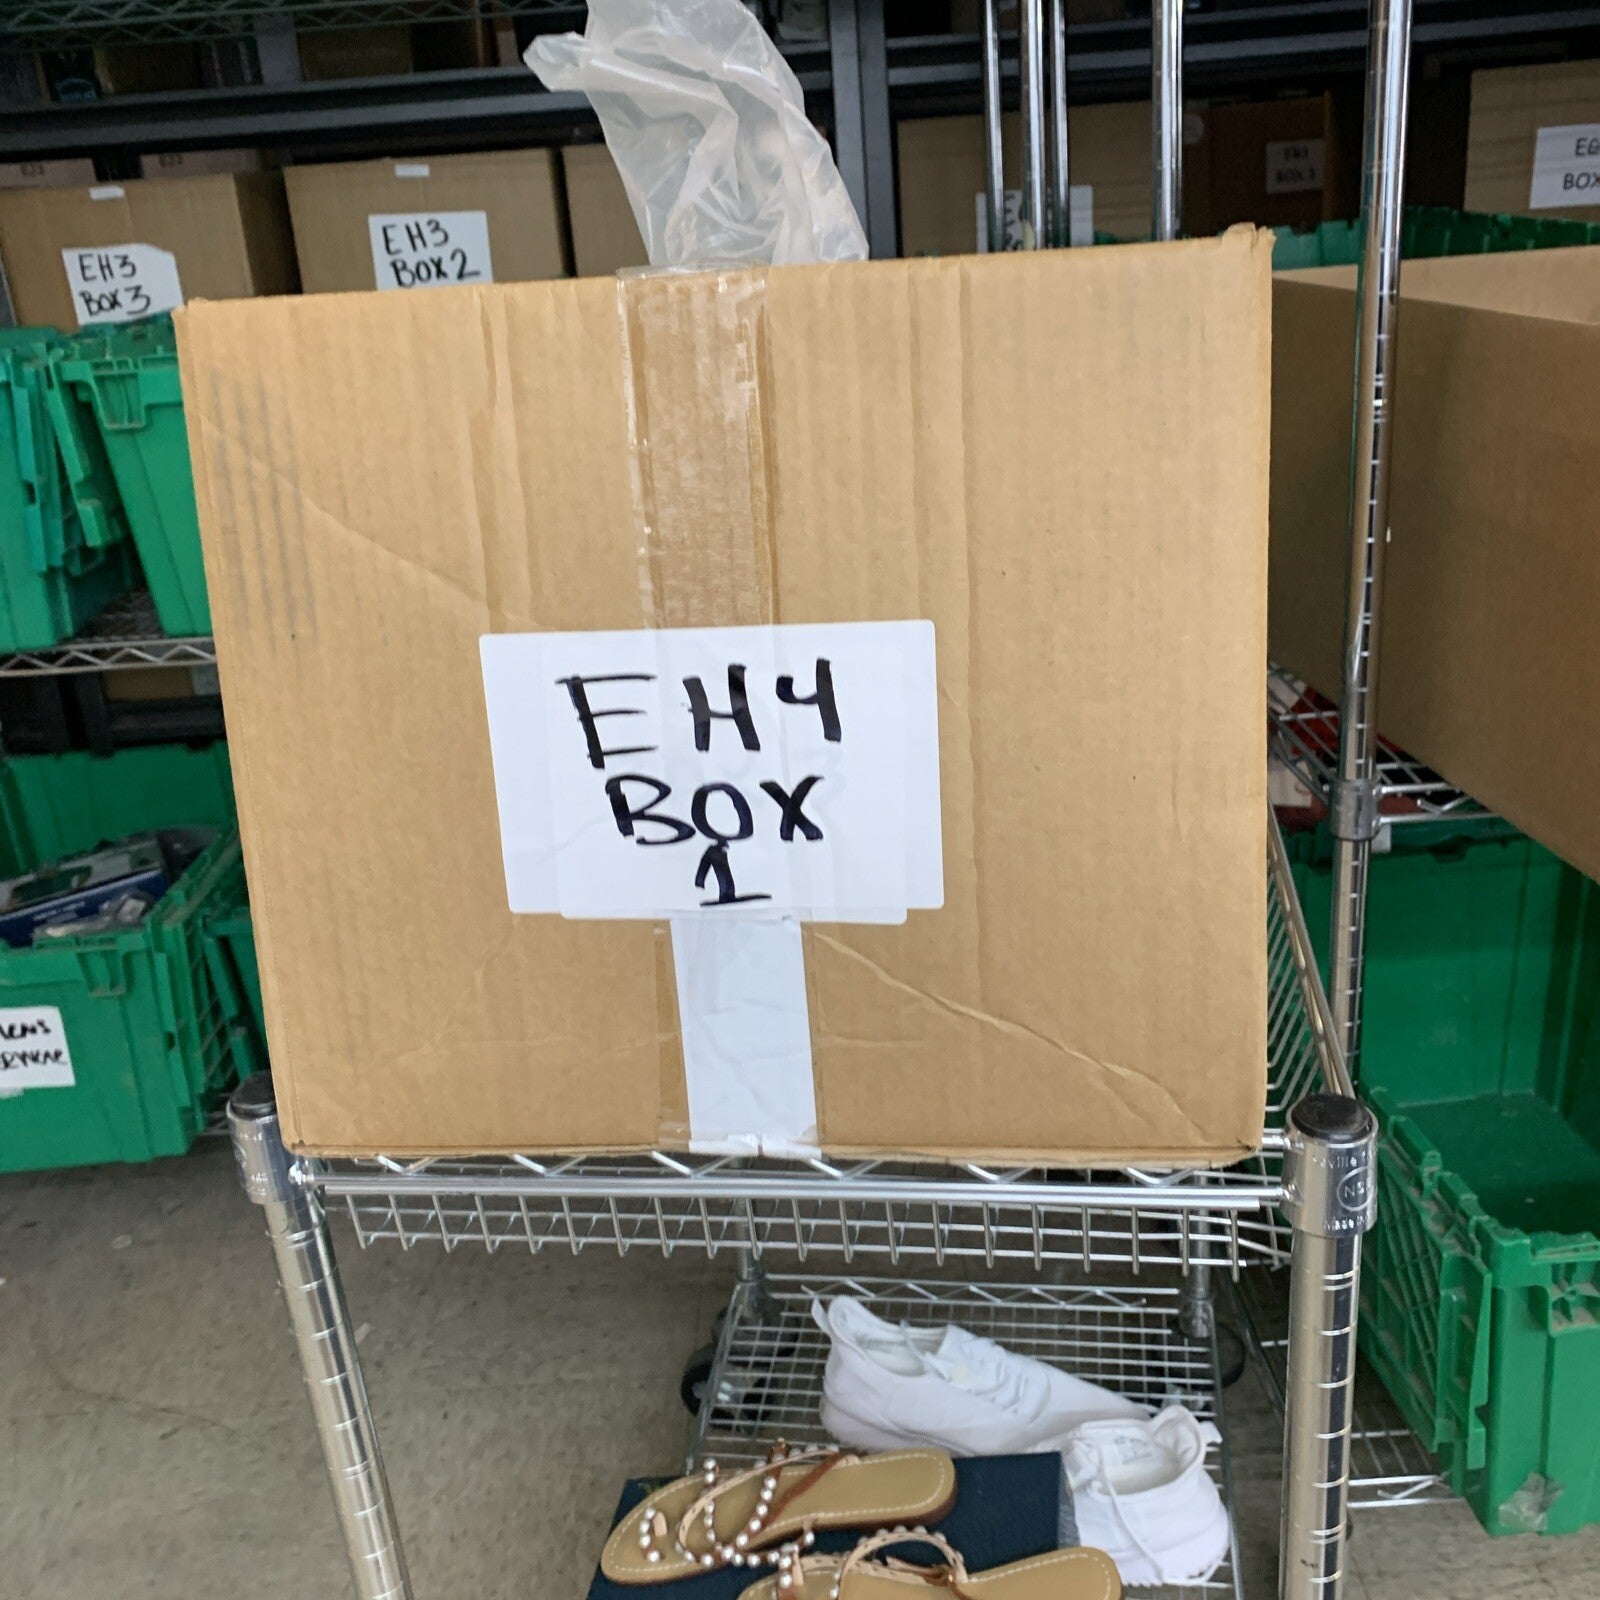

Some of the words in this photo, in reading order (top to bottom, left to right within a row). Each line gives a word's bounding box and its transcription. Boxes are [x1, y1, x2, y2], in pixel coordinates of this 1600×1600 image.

[382, 218, 449, 255] EH3
[78, 253, 136, 282] EH3
[450, 248, 482, 280] 2
[124, 285, 151, 316] 3
[555, 657, 841, 770] EH4
[605, 774, 823, 847] BOX
[694, 842, 772, 907] 1
